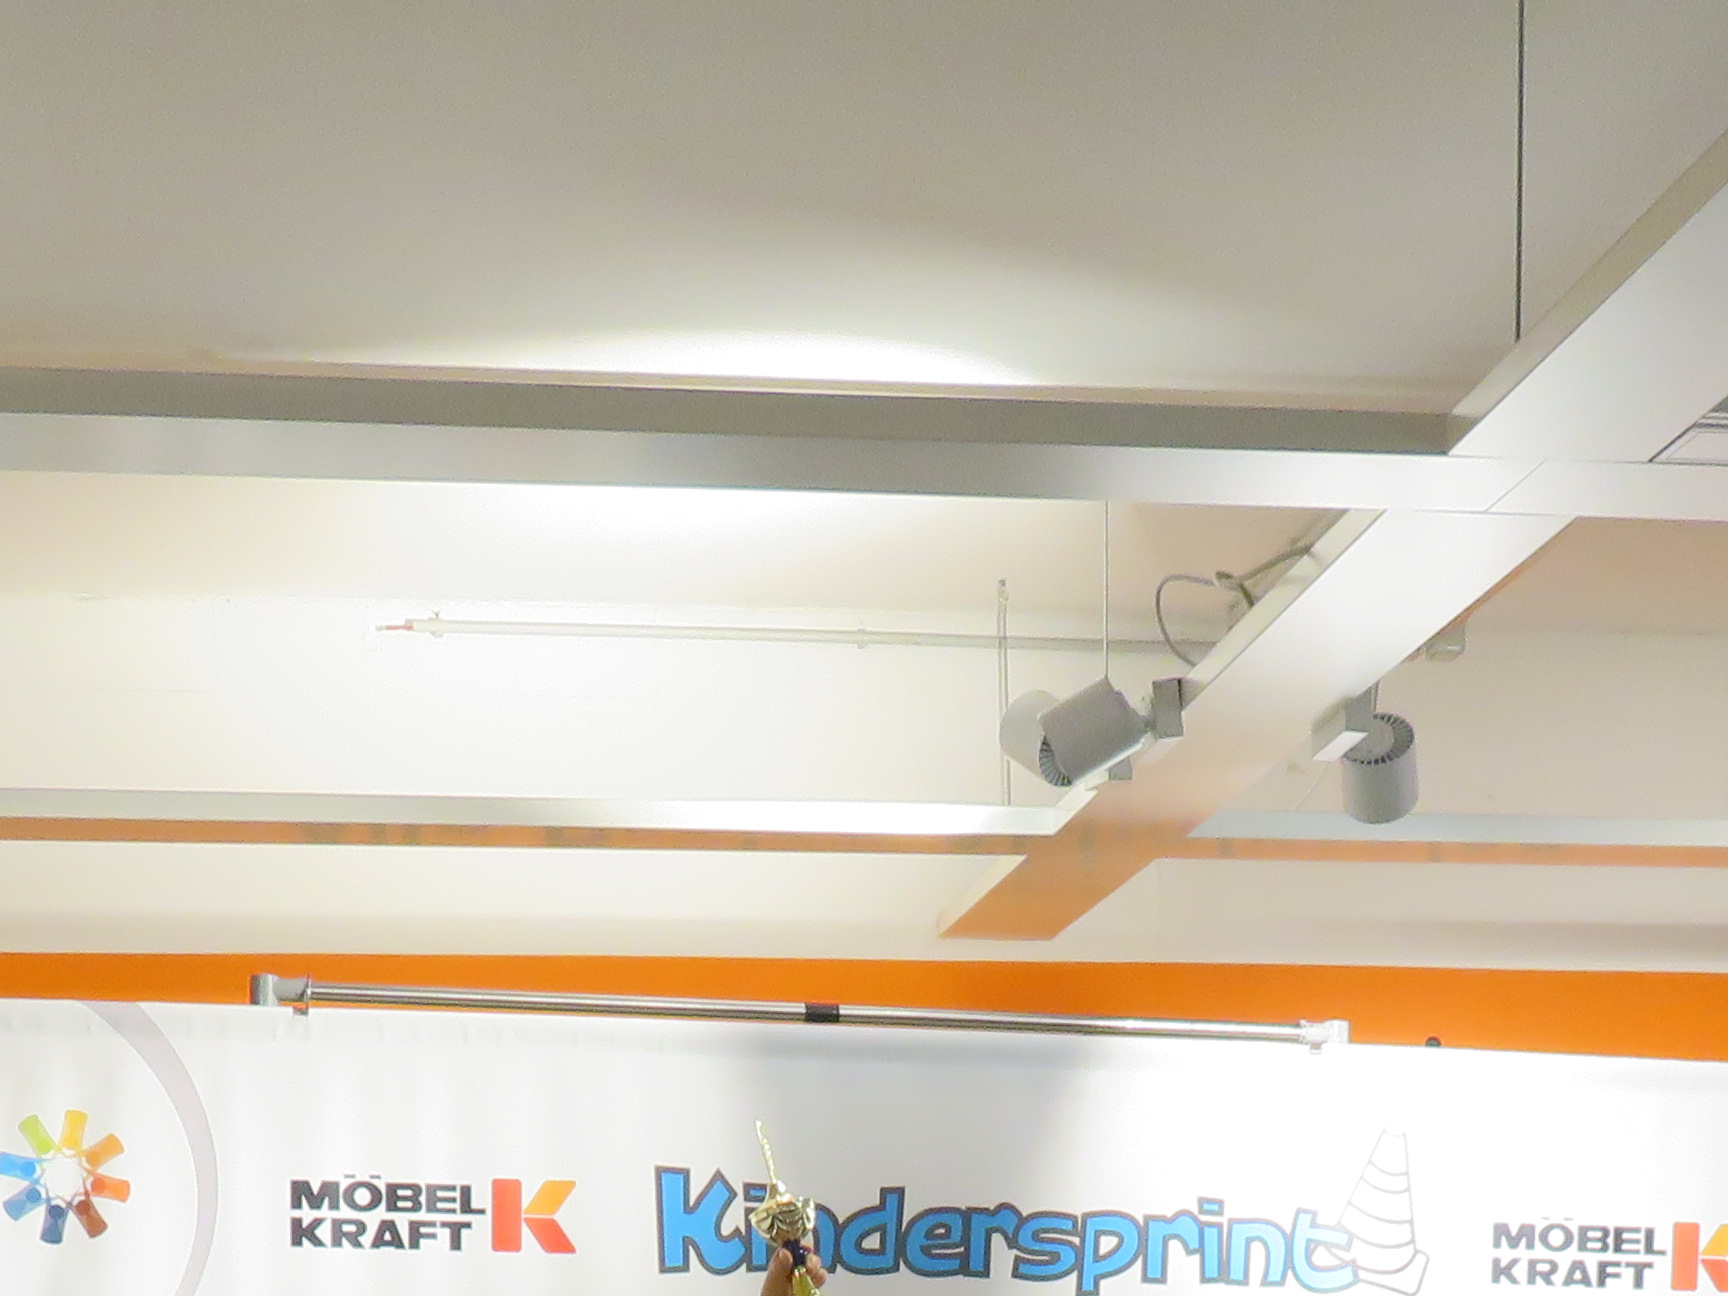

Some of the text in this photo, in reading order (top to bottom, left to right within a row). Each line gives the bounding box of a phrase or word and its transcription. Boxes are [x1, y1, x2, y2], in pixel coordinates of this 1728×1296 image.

[289, 1174, 486, 1216] MÖBEL
[289, 1216, 473, 1252] KRAFT
[1491, 1216, 1667, 1256] MÖBEL
[1490, 1257, 1654, 1290] KRAFT
